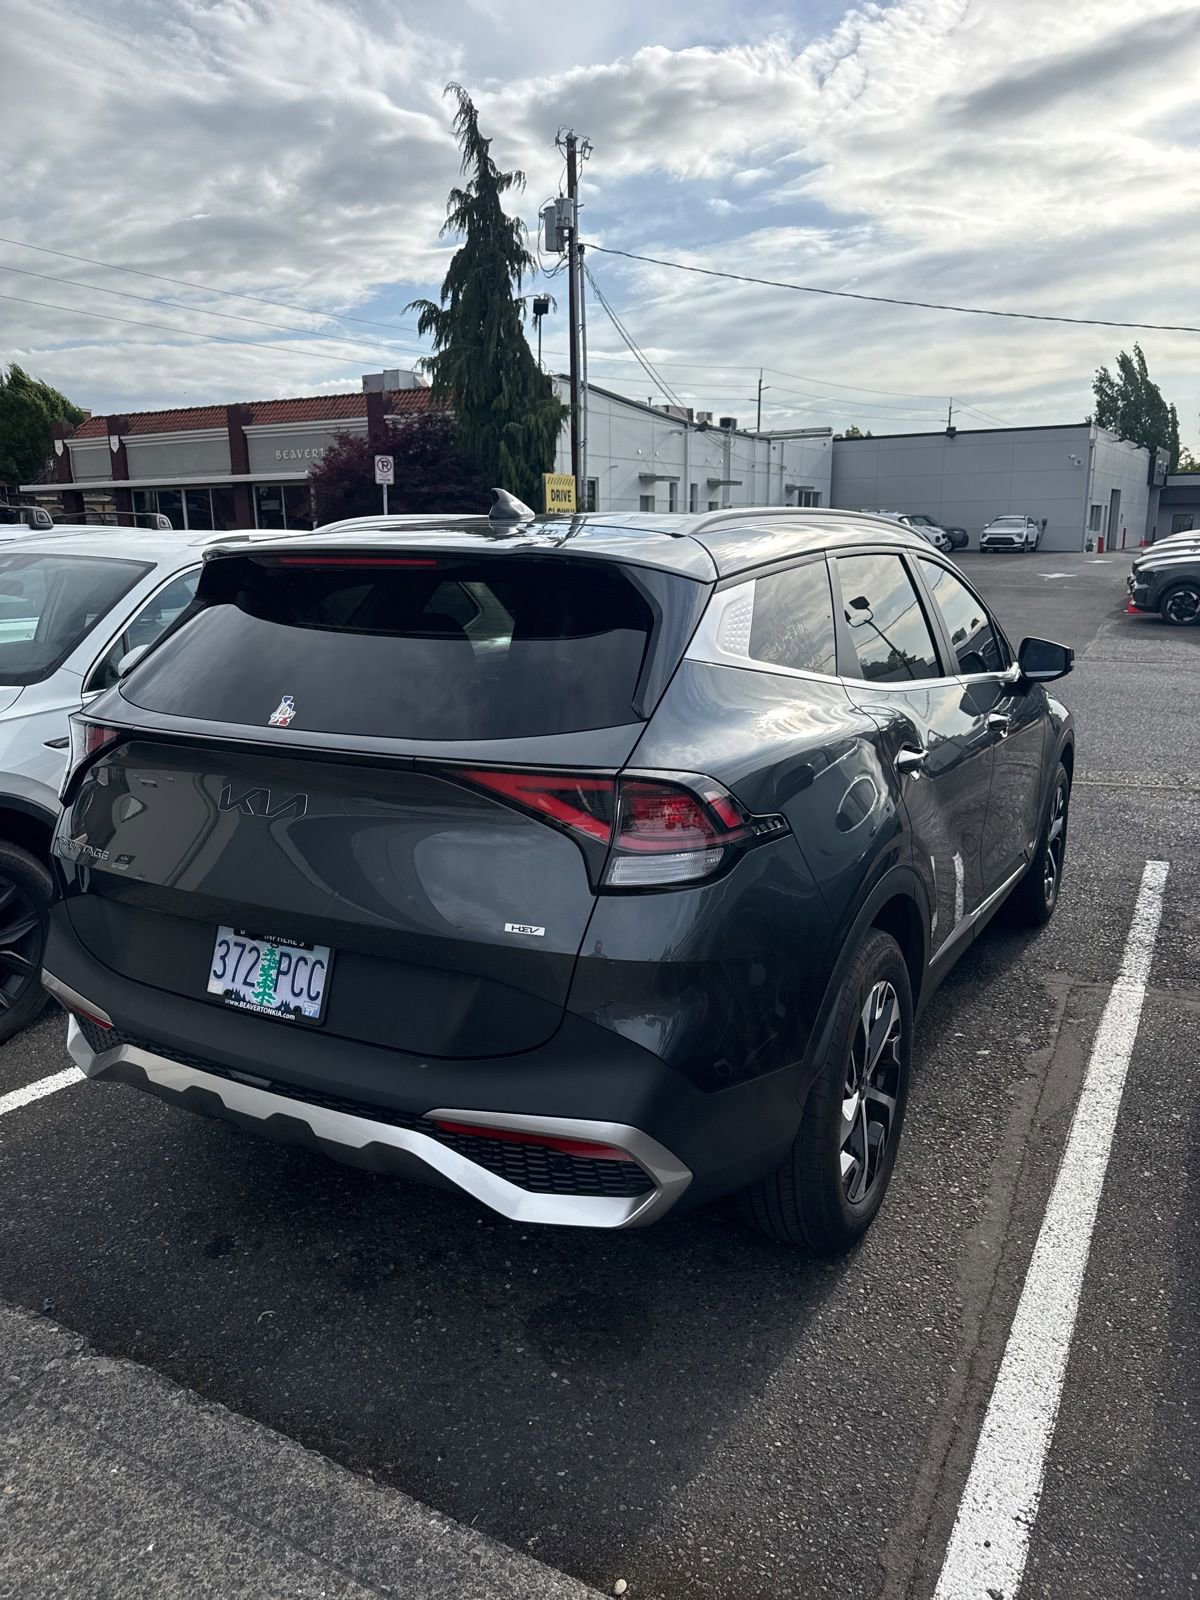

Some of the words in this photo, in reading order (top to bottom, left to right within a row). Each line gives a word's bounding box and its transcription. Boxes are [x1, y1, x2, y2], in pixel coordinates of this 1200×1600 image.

[550, 489, 572, 503] DRIVE
[511, 925, 540, 933] HEV
[213, 939, 260, 987] 372
[274, 951, 325, 1001] PCC
[224, 998, 296, 1020] www.BEAVERTONKIA.com
